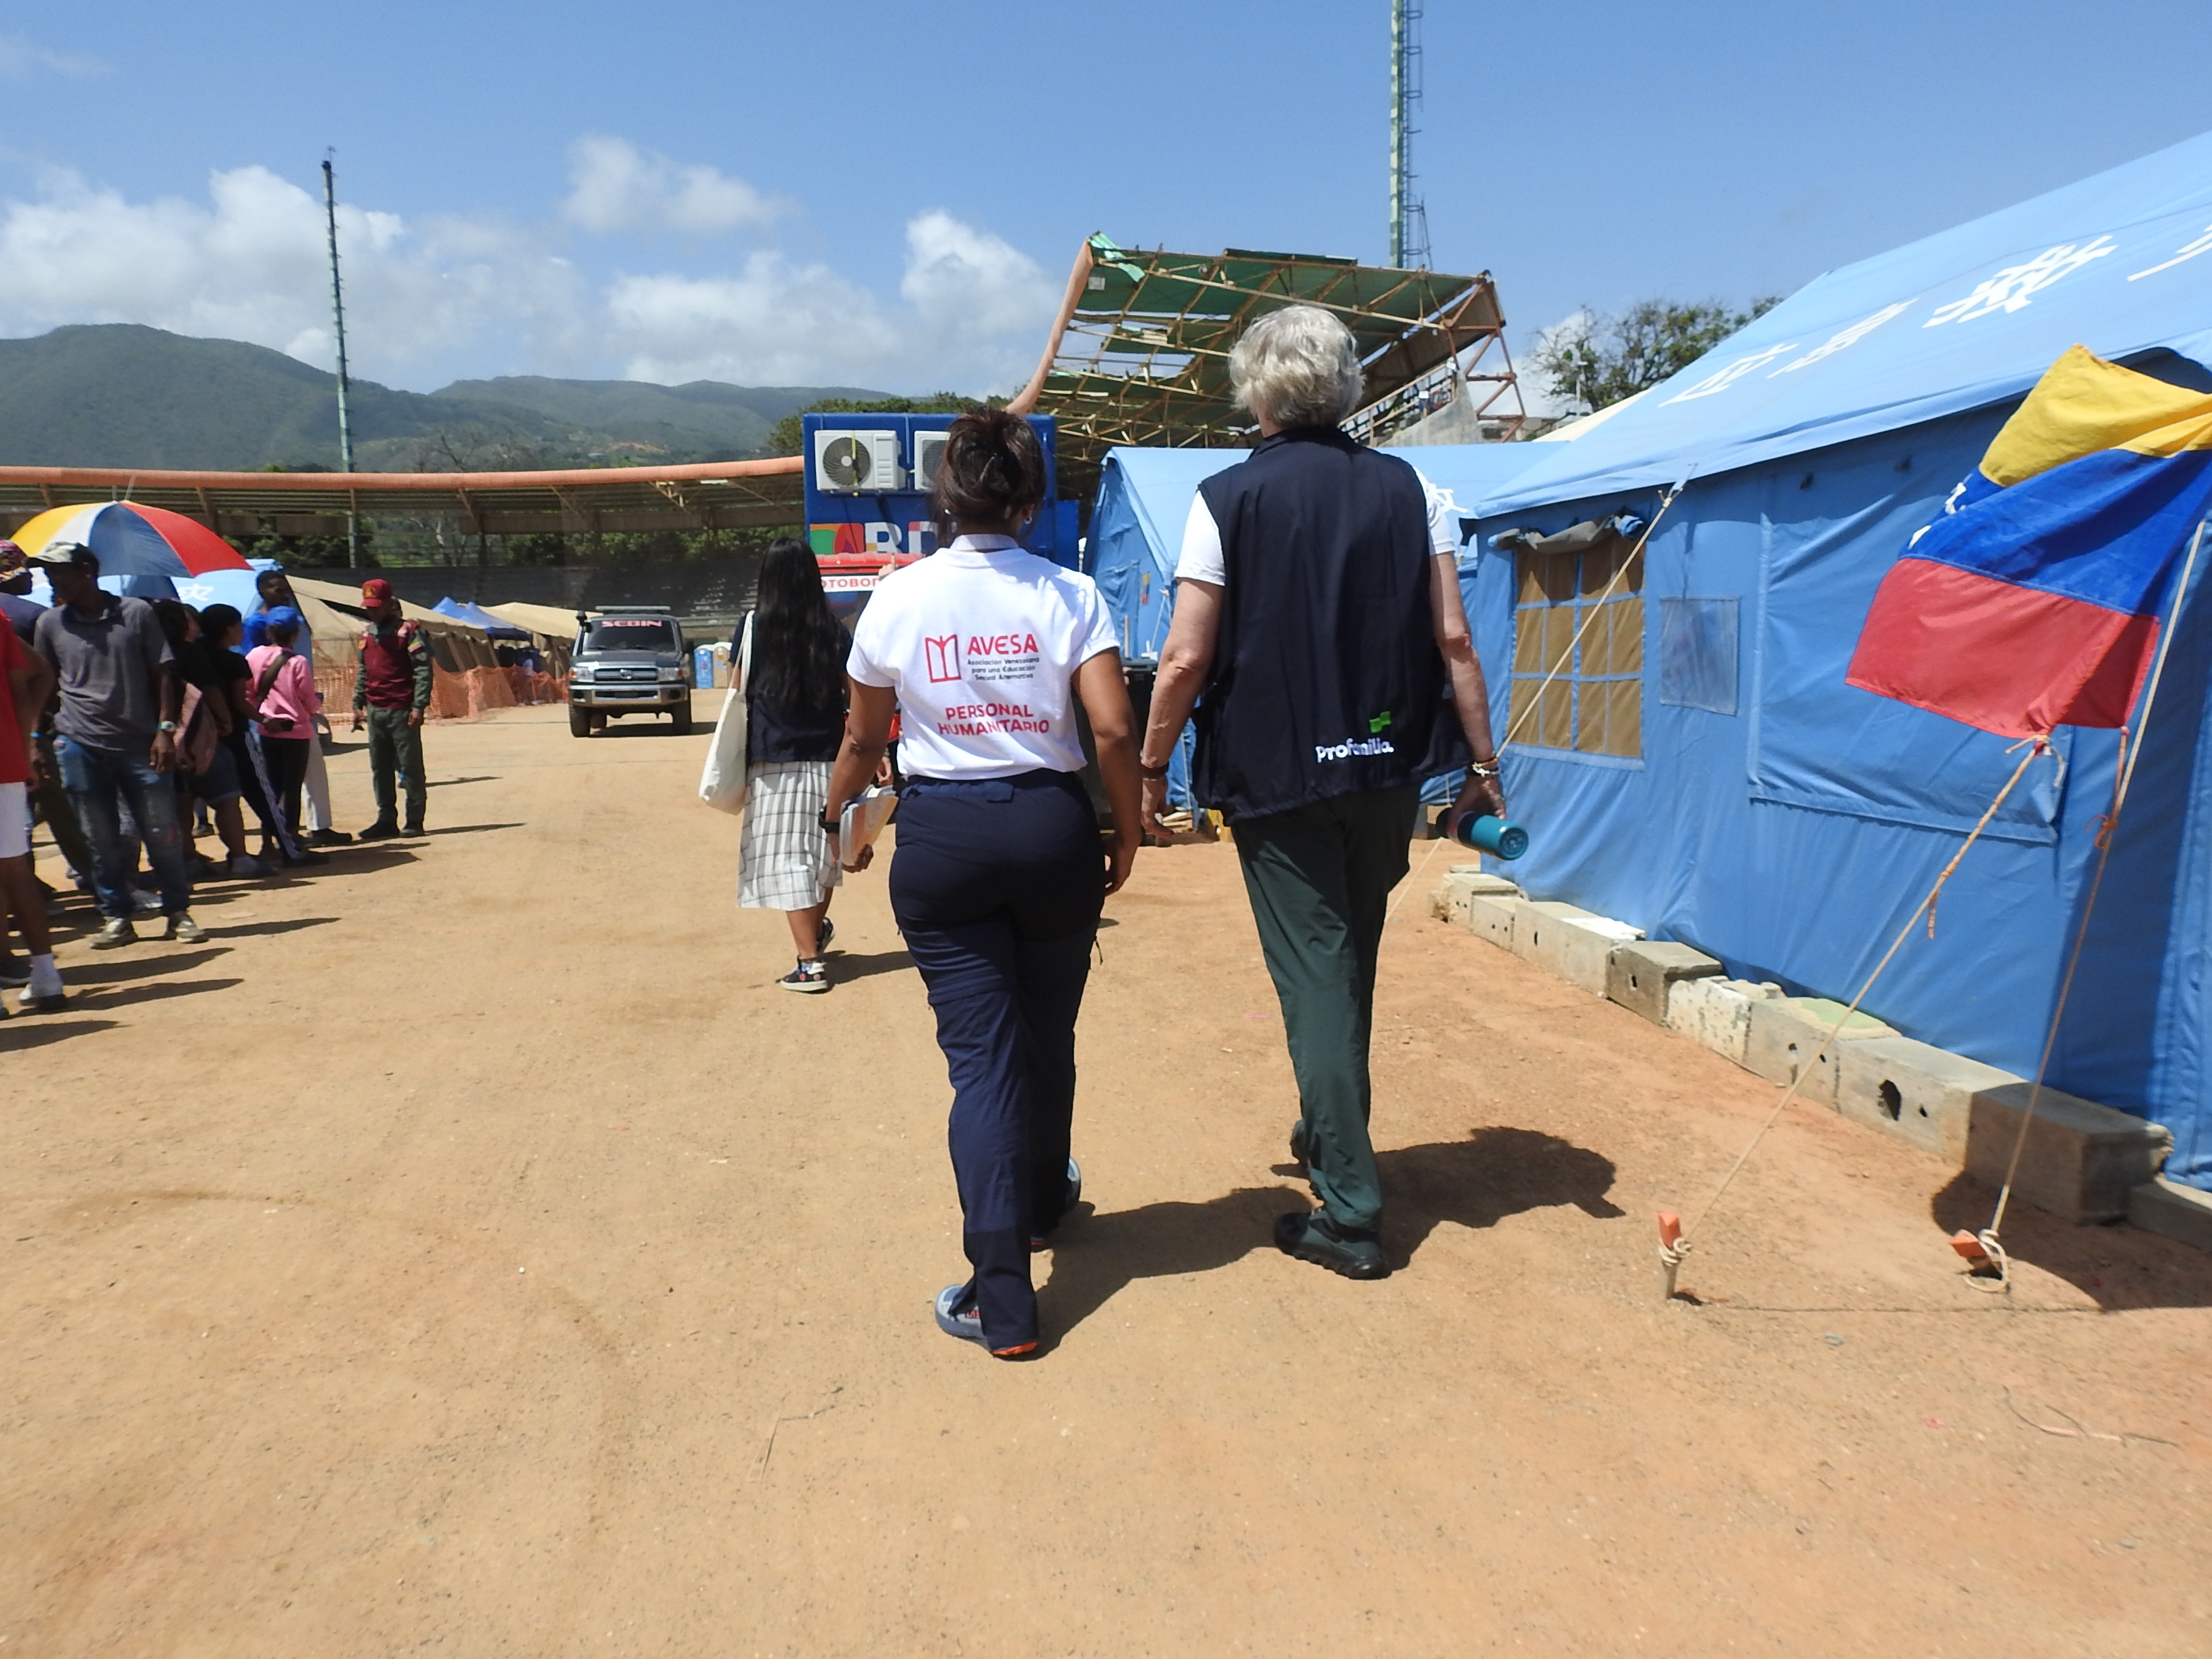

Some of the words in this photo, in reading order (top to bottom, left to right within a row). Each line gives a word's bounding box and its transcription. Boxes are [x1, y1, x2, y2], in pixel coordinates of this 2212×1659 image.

[967, 634, 1039, 656] AVESA
[945, 703, 1034, 721] PERSONAL
[937, 719, 1050, 736] HUMANITARIO
